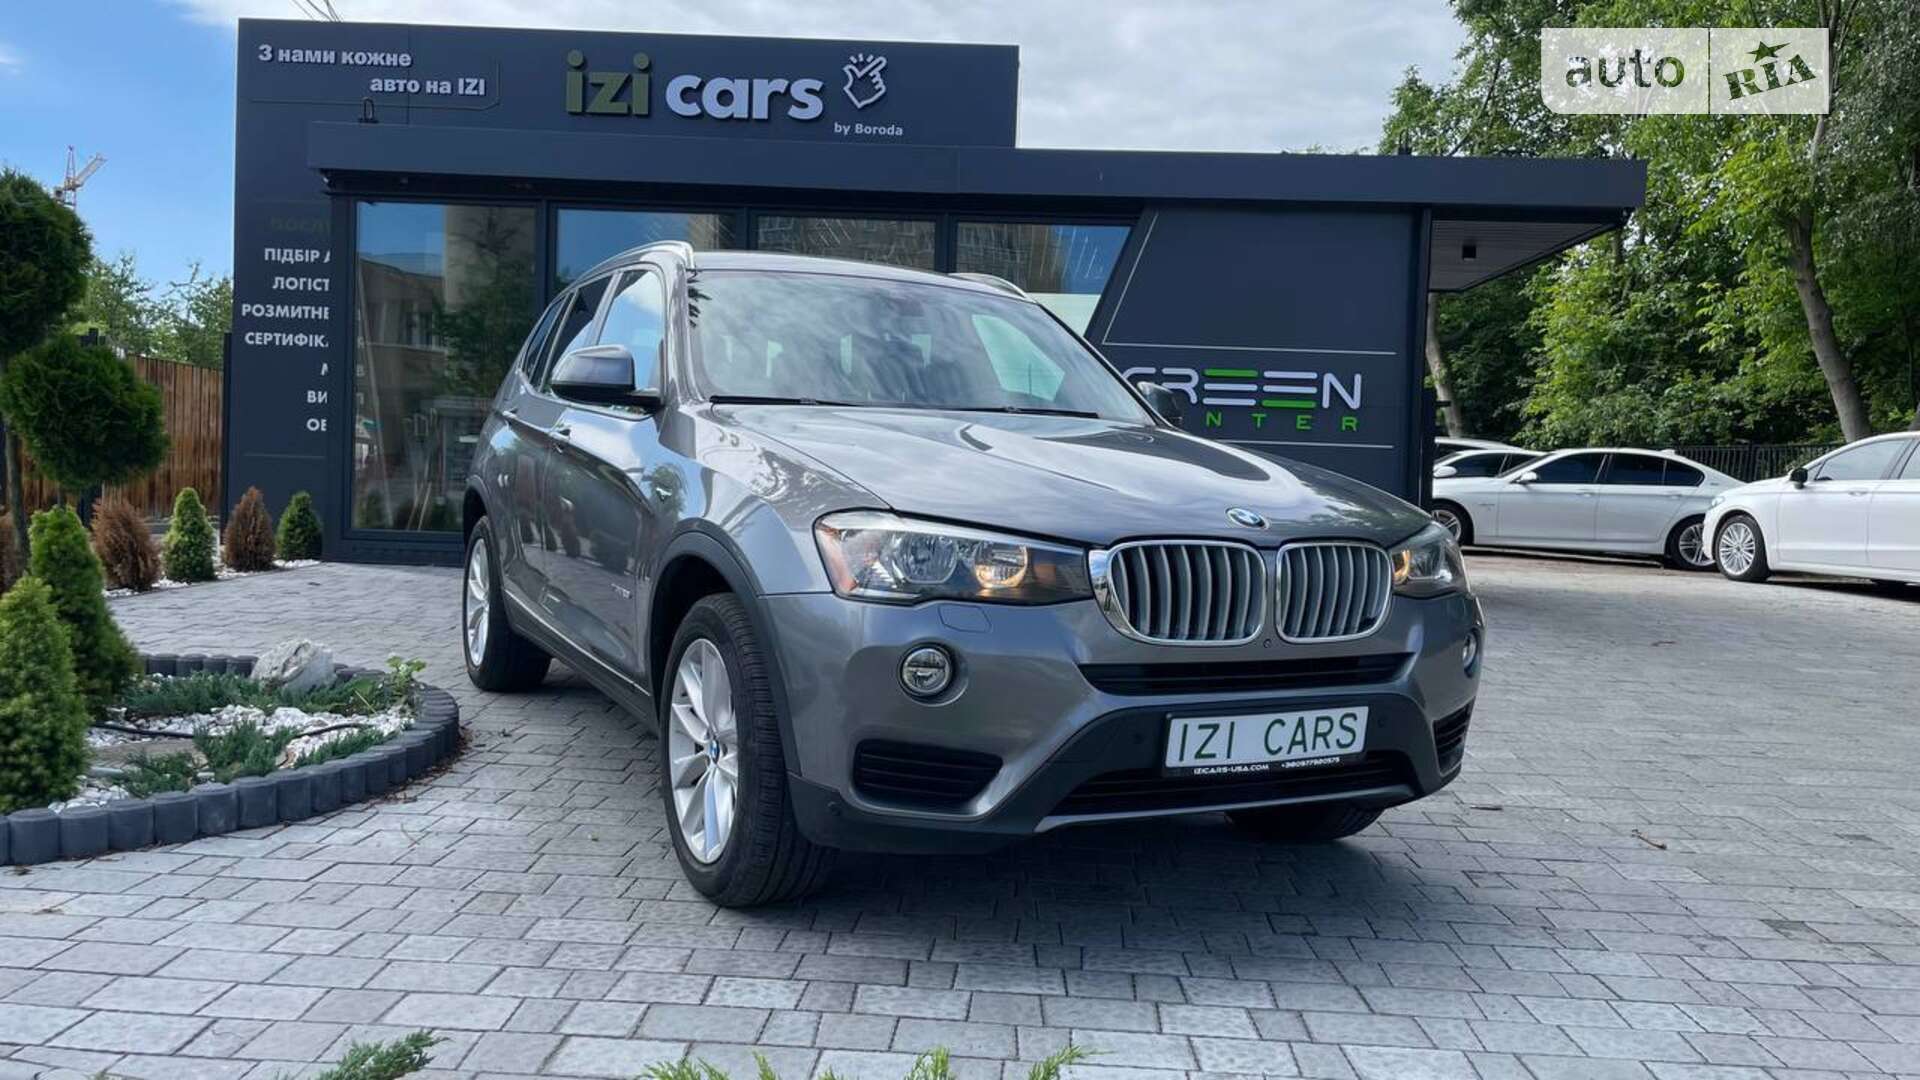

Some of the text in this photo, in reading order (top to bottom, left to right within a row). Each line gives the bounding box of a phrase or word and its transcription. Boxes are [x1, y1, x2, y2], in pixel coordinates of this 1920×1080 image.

[278, 48, 335, 64] нами
[341, 51, 412, 67] кожне
[370, 78, 486, 95] авто на IZI
[665, 74, 824, 120] cars
[834, 122, 903, 136] by Boroda
[264, 248, 320, 264] ПІДБІР
[244, 332, 329, 348] СЕРТИФІК
[1179, 712, 1358, 762] IZI CARS
